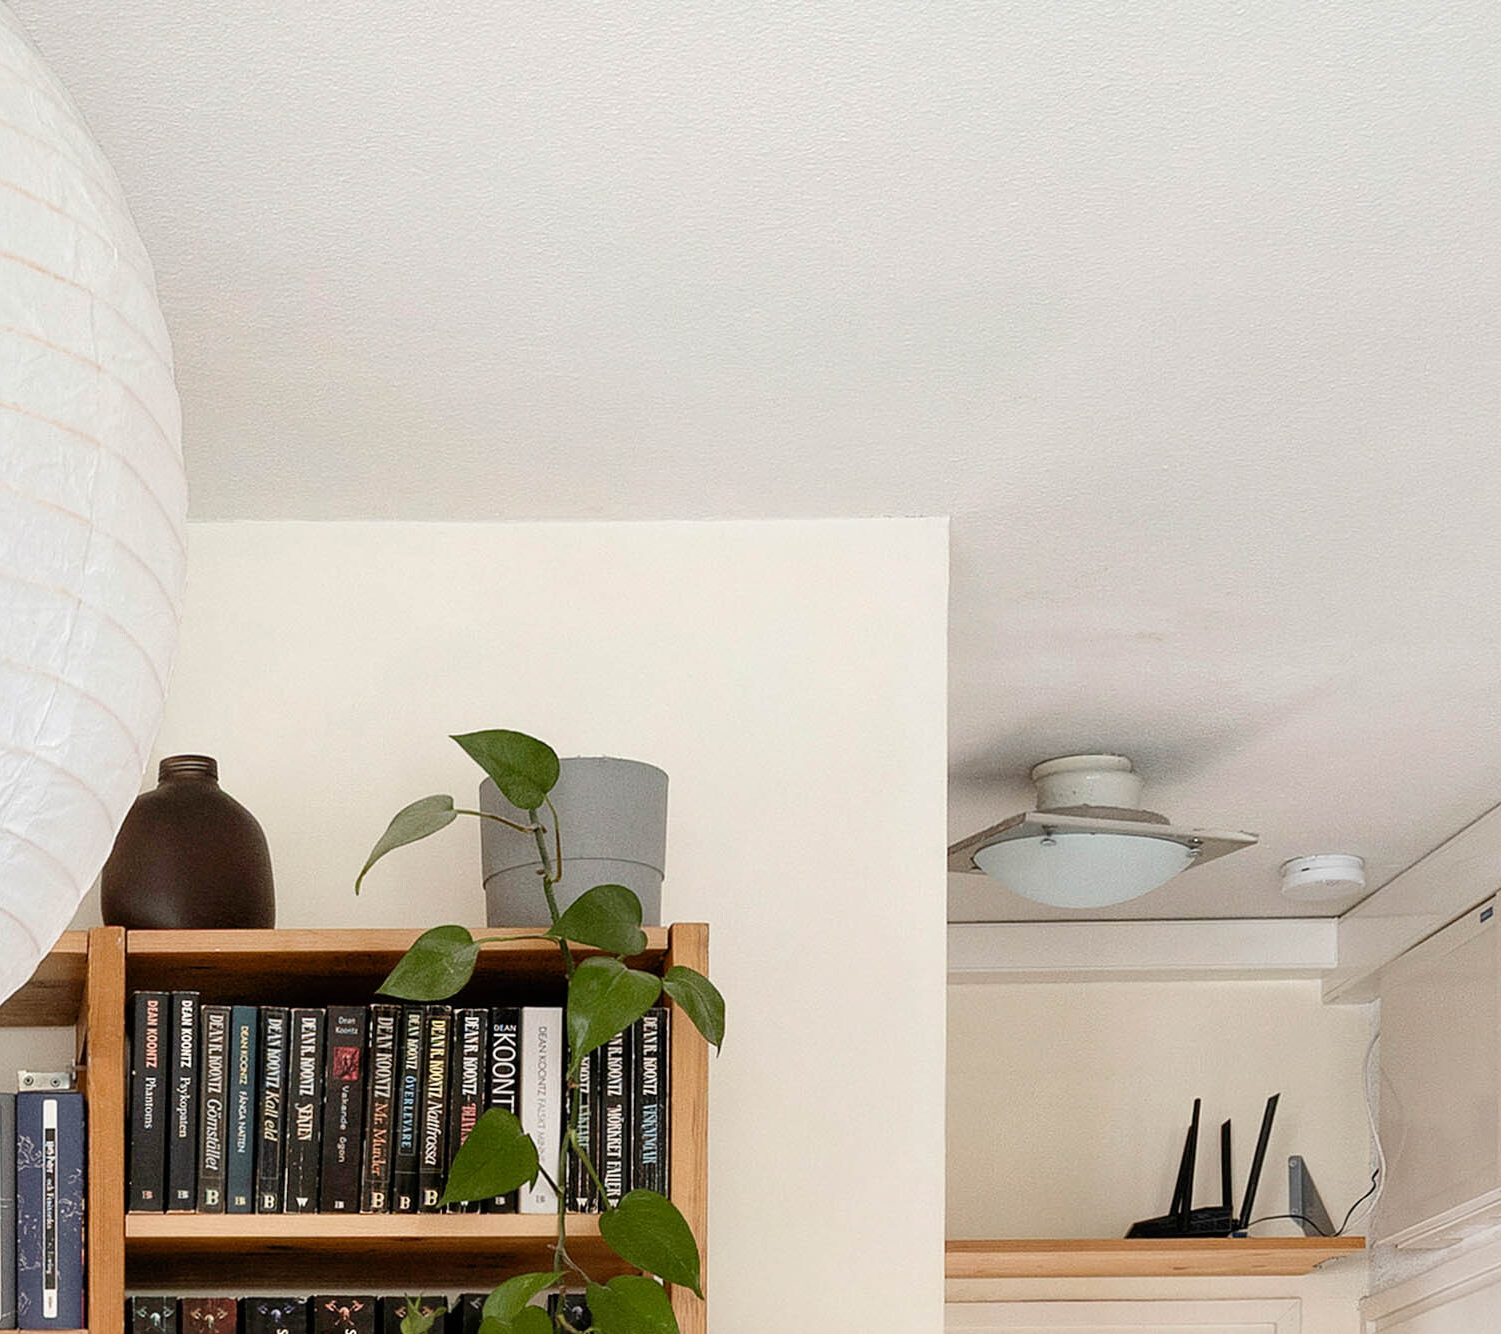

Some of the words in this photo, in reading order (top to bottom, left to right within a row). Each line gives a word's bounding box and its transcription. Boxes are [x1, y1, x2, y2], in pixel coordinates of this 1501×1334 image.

[144, 999, 159, 1026] DEAN
[180, 999, 192, 1026] DEAN
[147, 1028, 159, 1068] KOONTZ
[180, 1028, 192, 1068] KOONTZ
[144, 1076, 156, 1128] Phantoms
[178, 1076, 189, 1138] Psykopaten
